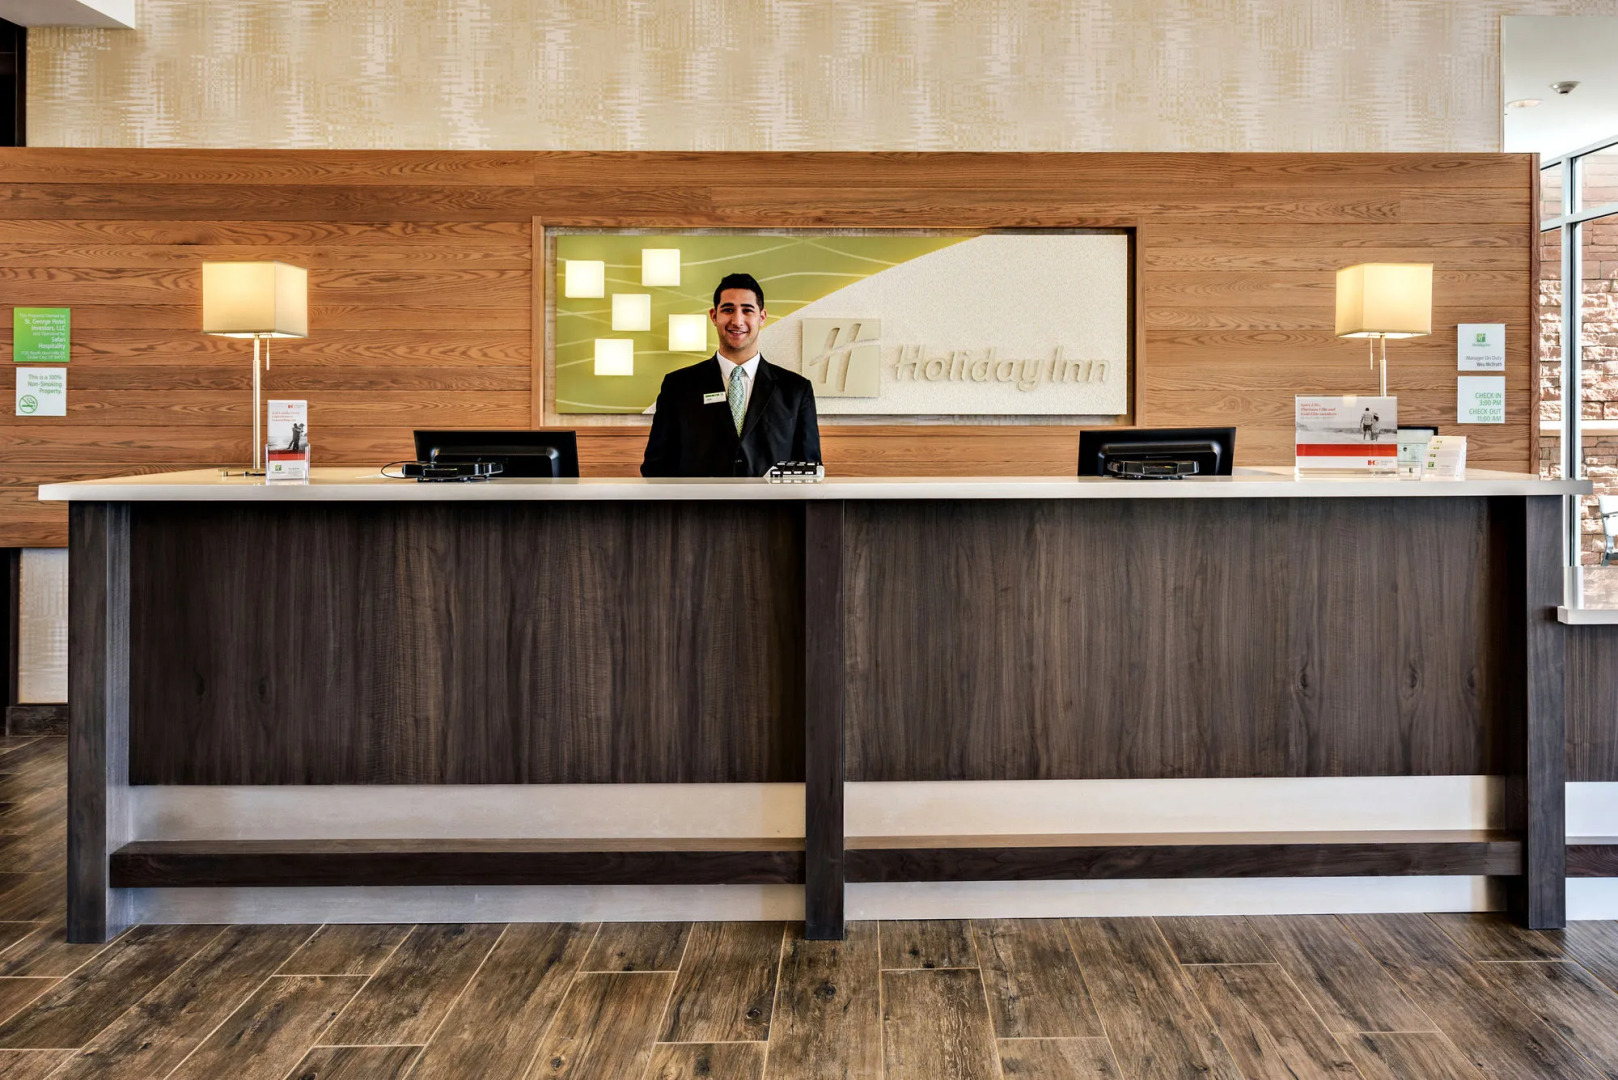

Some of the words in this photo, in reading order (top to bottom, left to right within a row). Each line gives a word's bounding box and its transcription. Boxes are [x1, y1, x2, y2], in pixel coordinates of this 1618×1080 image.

[32, 318, 51, 326] George
[895, 345, 1044, 392] Holiday
[1050, 345, 1110, 383] Inn
[28, 380, 62, 388] Non-Smoking
